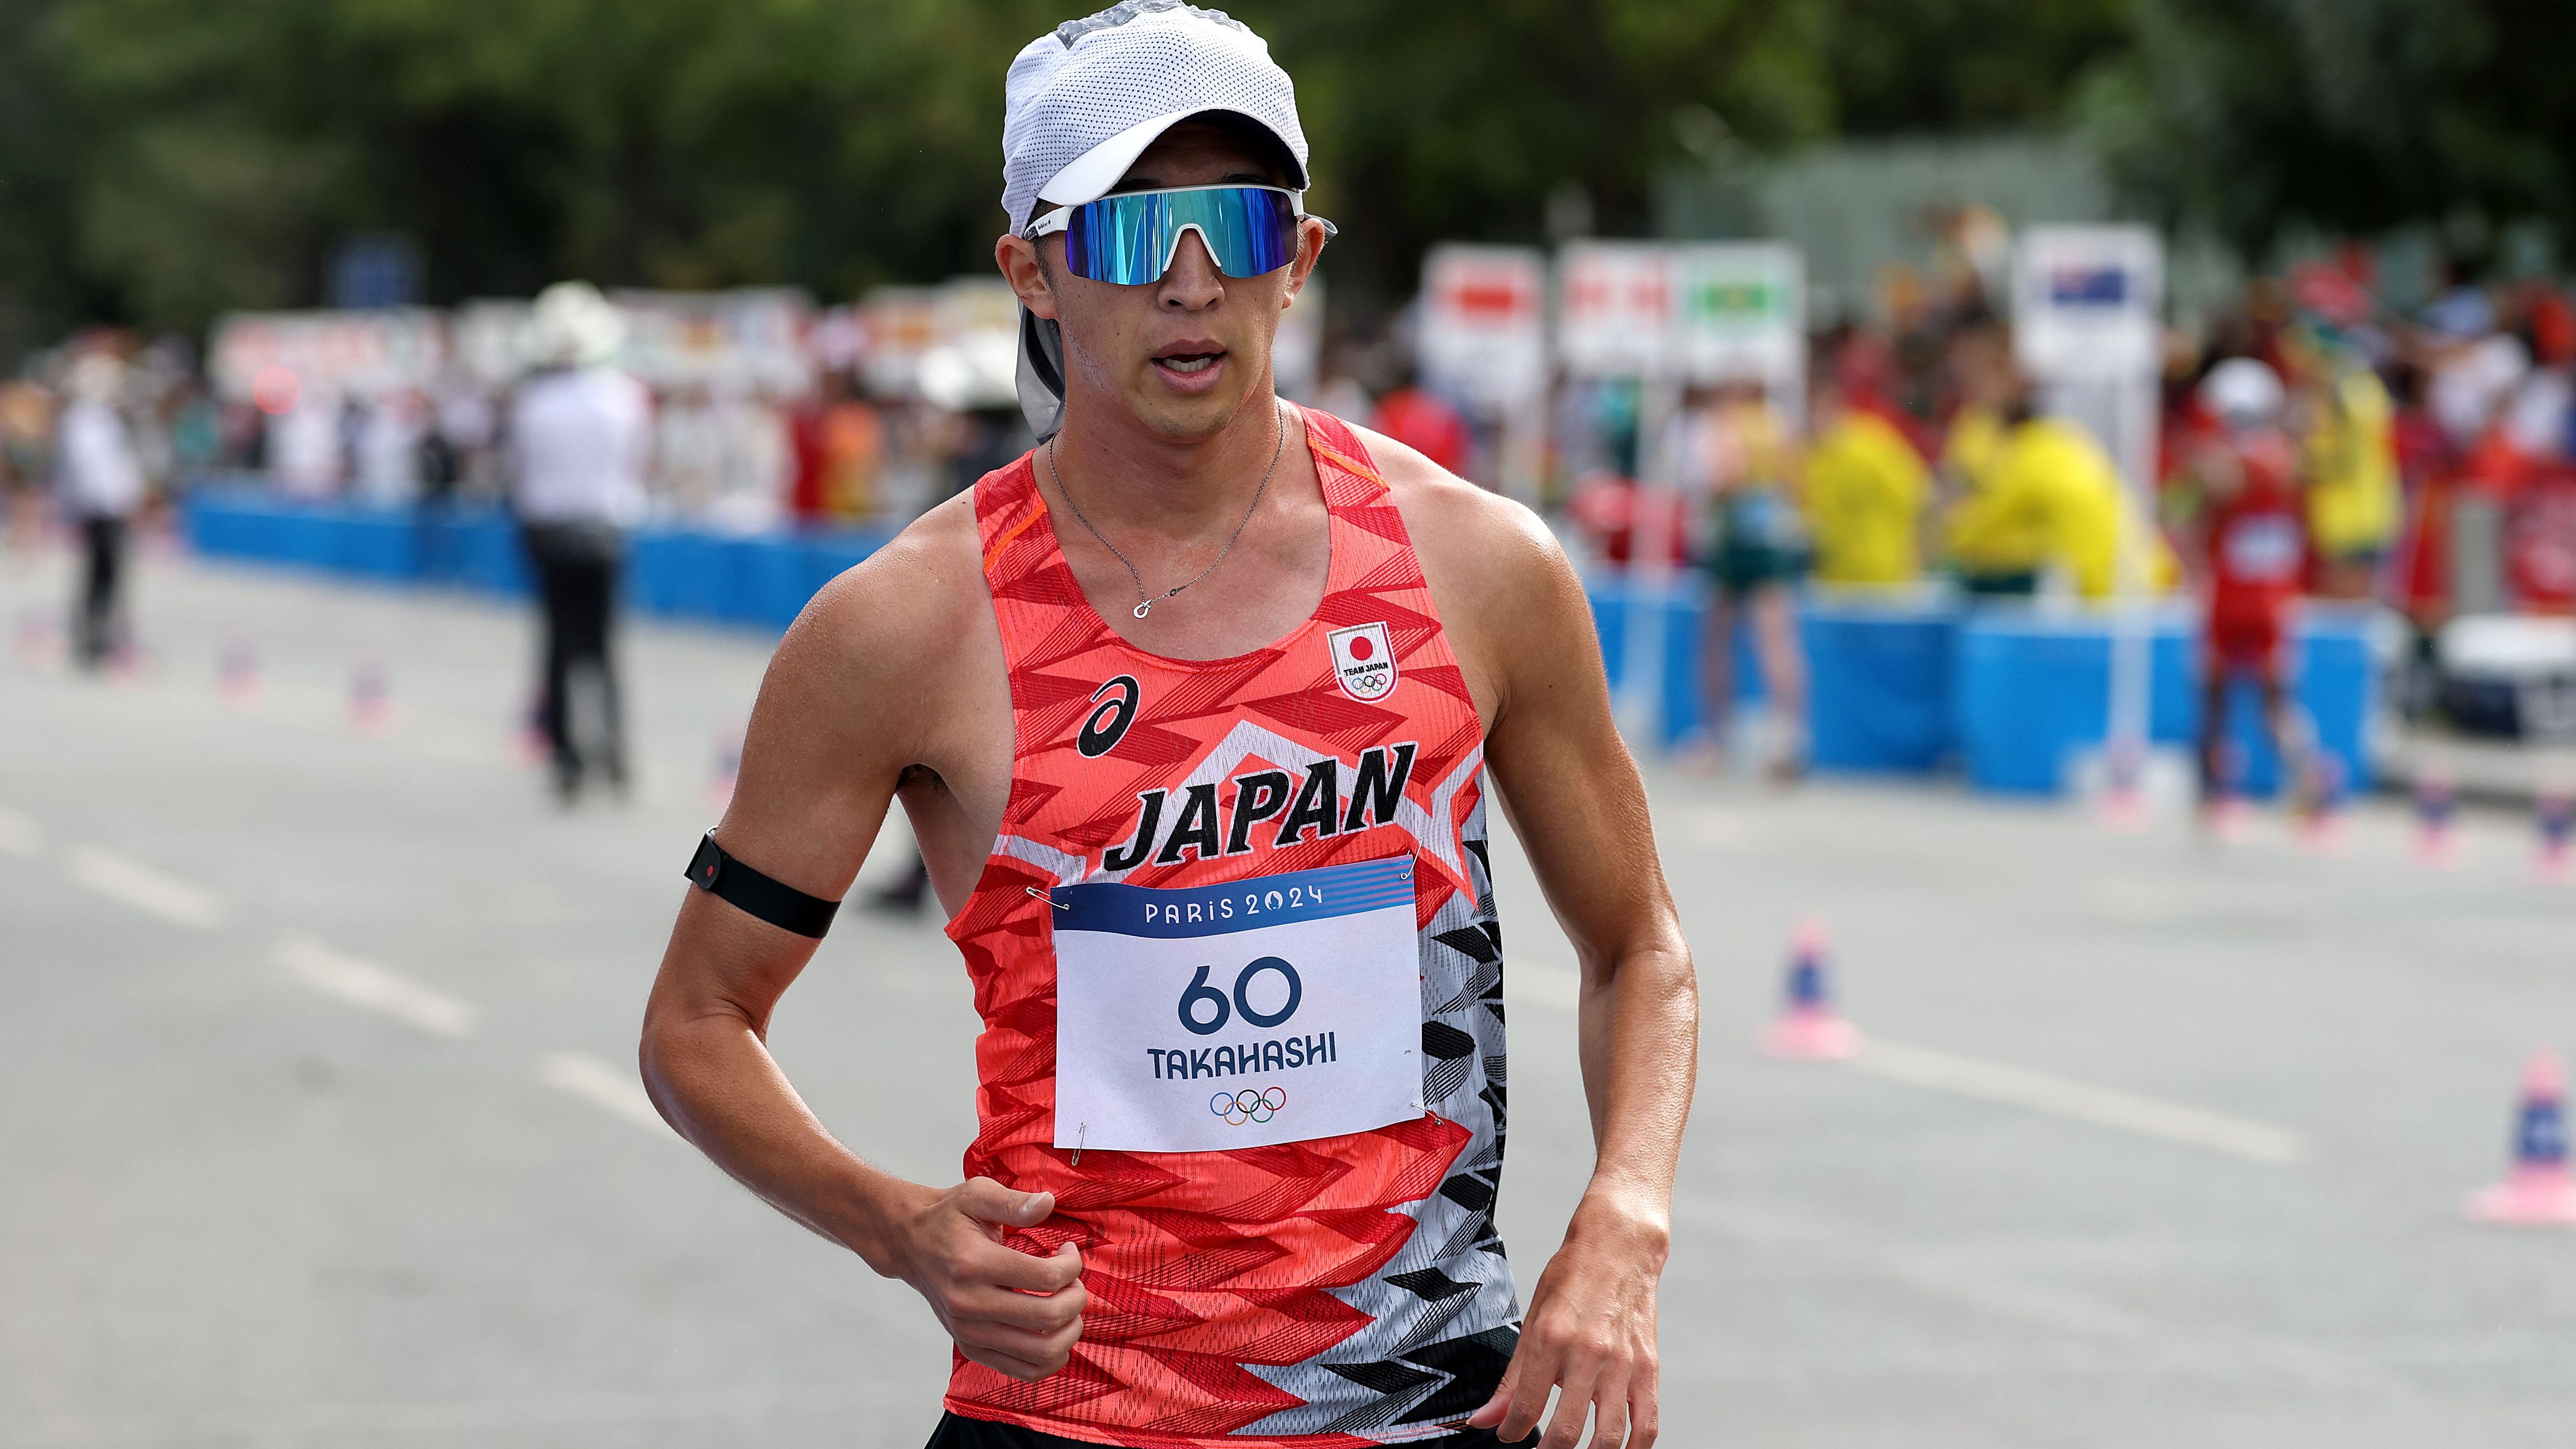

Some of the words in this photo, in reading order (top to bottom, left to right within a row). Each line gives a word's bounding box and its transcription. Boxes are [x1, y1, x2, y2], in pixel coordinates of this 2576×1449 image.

[1343, 666, 1365, 676] TEAM
[1365, 661, 1389, 672] JAPAN
[1102, 742, 1417, 873] JAPAN
[1245, 885, 1322, 915] 2024
[1178, 956, 1302, 1035] 60
[1147, 1031, 1337, 1080] TAKAHASHI
